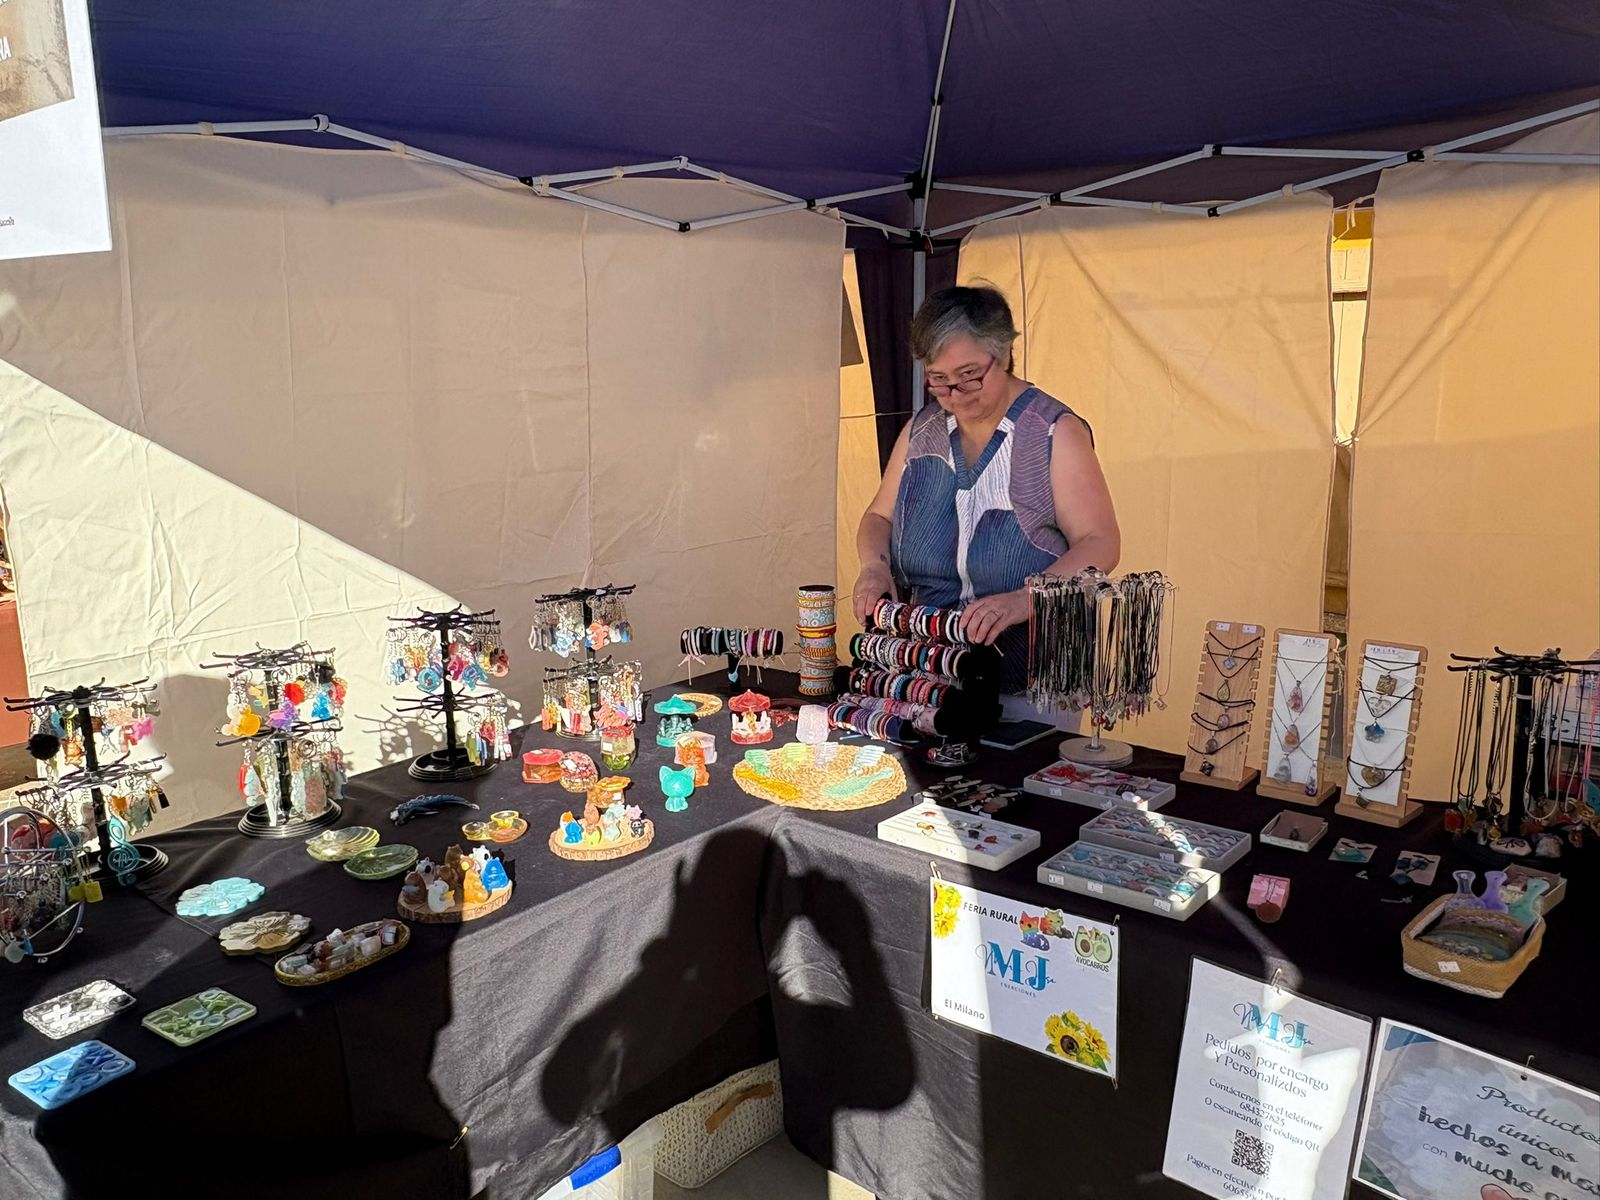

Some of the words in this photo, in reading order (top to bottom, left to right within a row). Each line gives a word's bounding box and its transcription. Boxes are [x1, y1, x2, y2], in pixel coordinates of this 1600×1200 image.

[963, 901, 987, 917] FERIA
[990, 908, 1018, 925] RURAL
[944, 999, 952, 1009] El
[954, 1001, 985, 1020] Milano
[1205, 1033, 1252, 1060] Pedidos
[1256, 1056, 1278, 1070] por
[1280, 1066, 1329, 1091] encargo
[1215, 1051, 1224, 1063] Y
[1224, 1055, 1308, 1098] Personalizdos
[1204, 1097, 1213, 1106] O
[1213, 1102, 1262, 1128] escaneando
[1264, 1123, 1272, 1133] el
[1304, 1140, 1320, 1153] QR
[1262, 1102, 1274, 1112] en
[1275, 1106, 1284, 1116] el
[1476, 1086, 1600, 1145] Producto
[1418, 1105, 1512, 1157] hechos
[1521, 1153, 1544, 1170] a
[1498, 1123, 1579, 1164] únicos
[1186, 1153, 1211, 1171] Pagos
[1212, 1167, 1223, 1177] en
[1422, 1142, 1448, 1158] con
[1454, 1151, 1536, 1193] mucho
